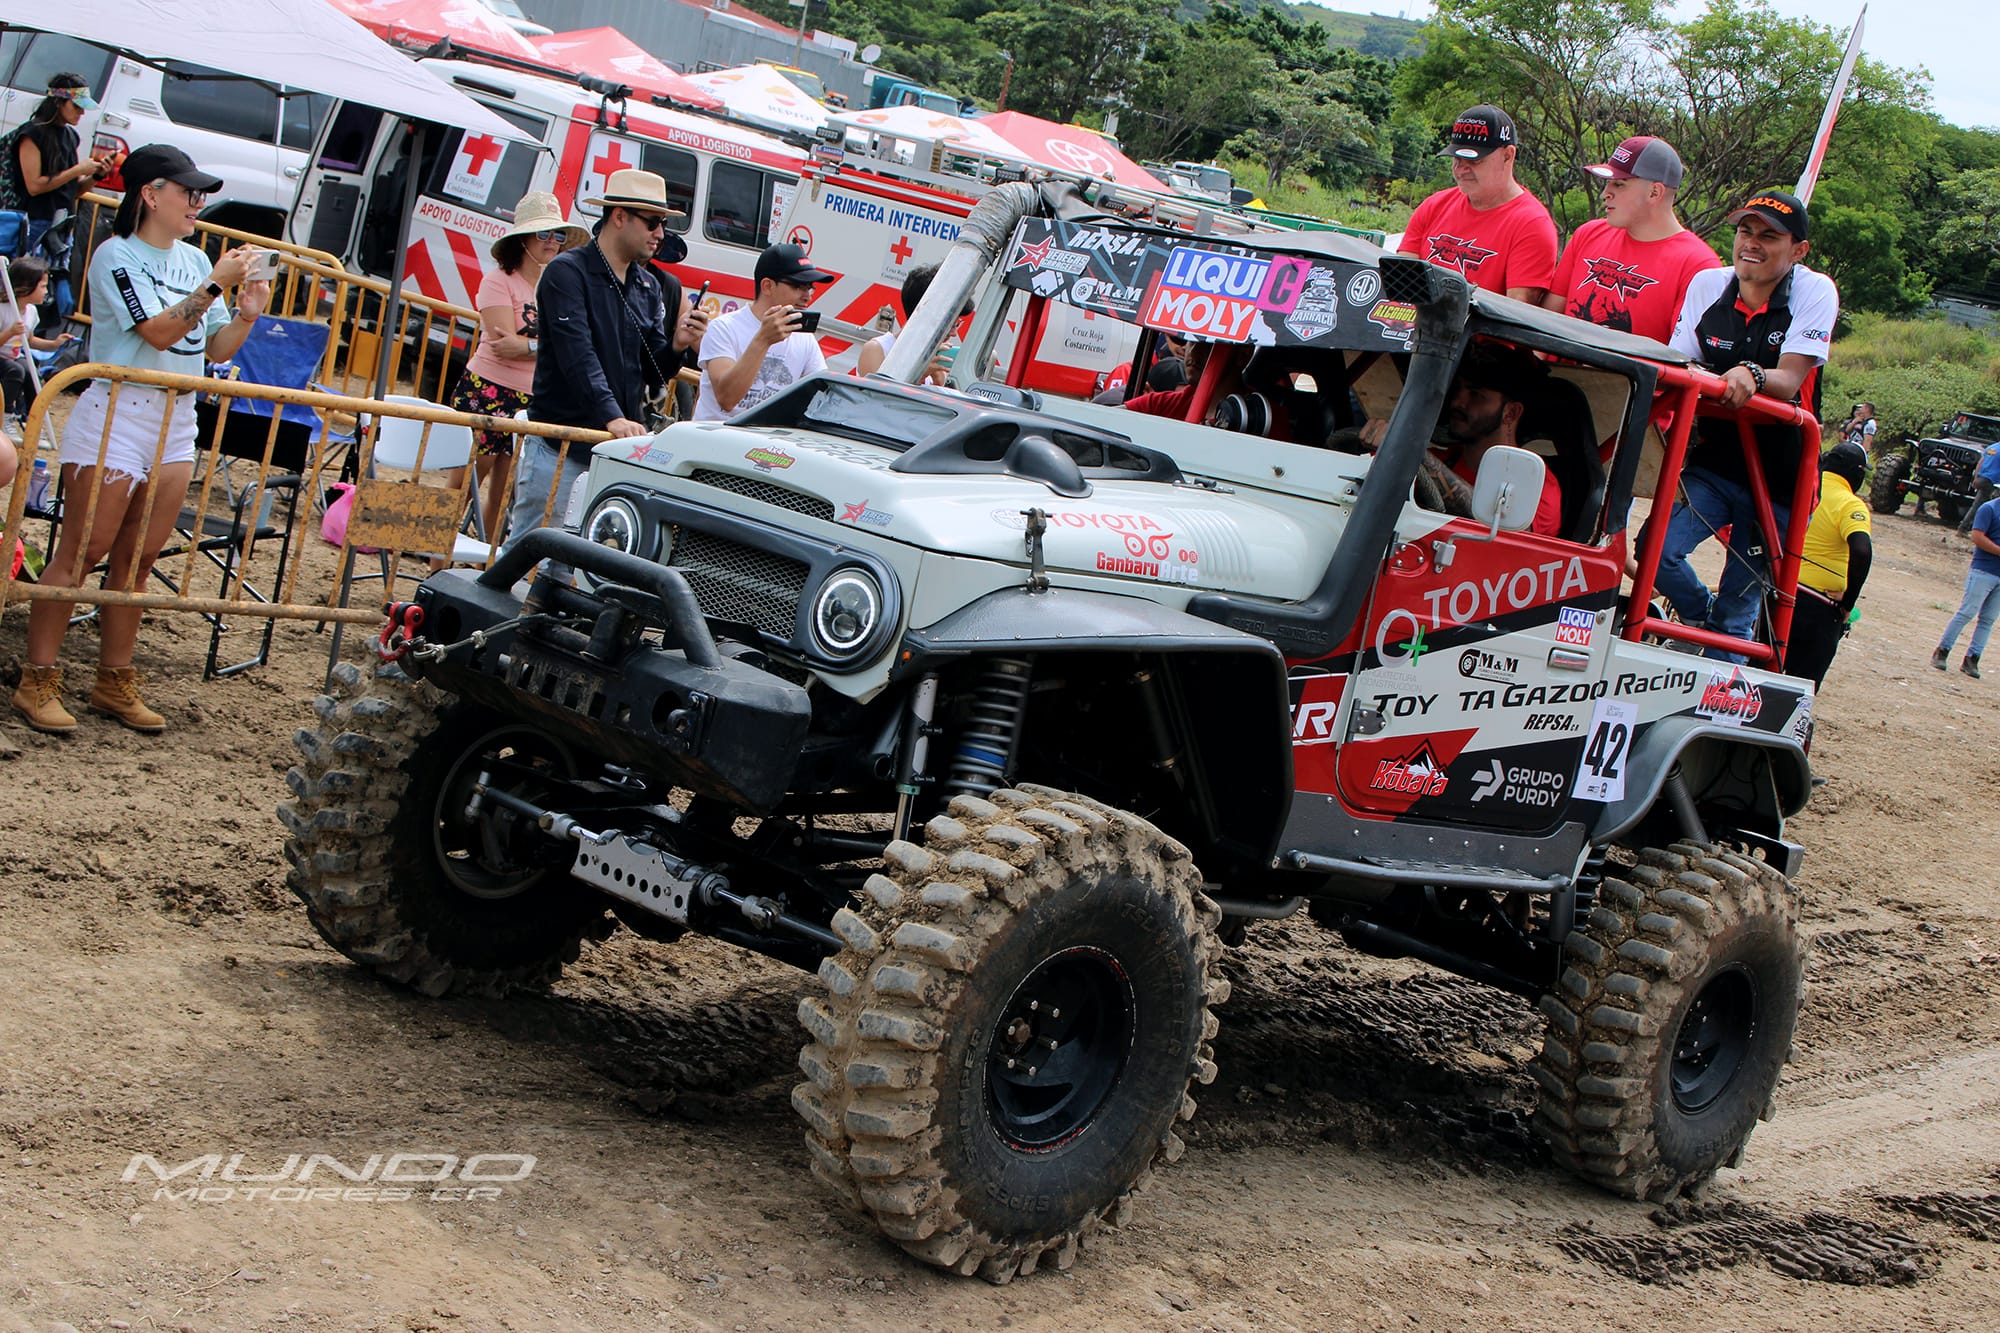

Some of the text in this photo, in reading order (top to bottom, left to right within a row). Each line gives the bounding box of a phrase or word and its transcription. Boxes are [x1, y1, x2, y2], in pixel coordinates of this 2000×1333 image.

[668, 128, 752, 159] APOYO LOGISTICO
[1500, 126, 1511, 141] 42
[420, 202, 507, 238] APOYO LOGISTICO
[824, 193, 884, 224] PRIMERA
[1166, 252, 1268, 298] LIQUI
[1268, 263, 1299, 306] C
[1152, 290, 1255, 337] MOLY
[1064, 338, 1106, 354] Costarricense
[1072, 326, 1104, 342] Cruz Roja
[1050, 512, 1162, 531] TOYOTA
[1424, 556, 1589, 630] TOYOTA
[1561, 609, 1595, 626] LIQUI
[1557, 627, 1591, 644] MOLY
[1502, 680, 1608, 708] GAZOO
[1614, 668, 1697, 695] Racing
[1523, 713, 1574, 731] REPSA
[1584, 721, 1627, 779] 42
[1507, 767, 1565, 790] GRUPO
[1504, 786, 1560, 808] PURDY
